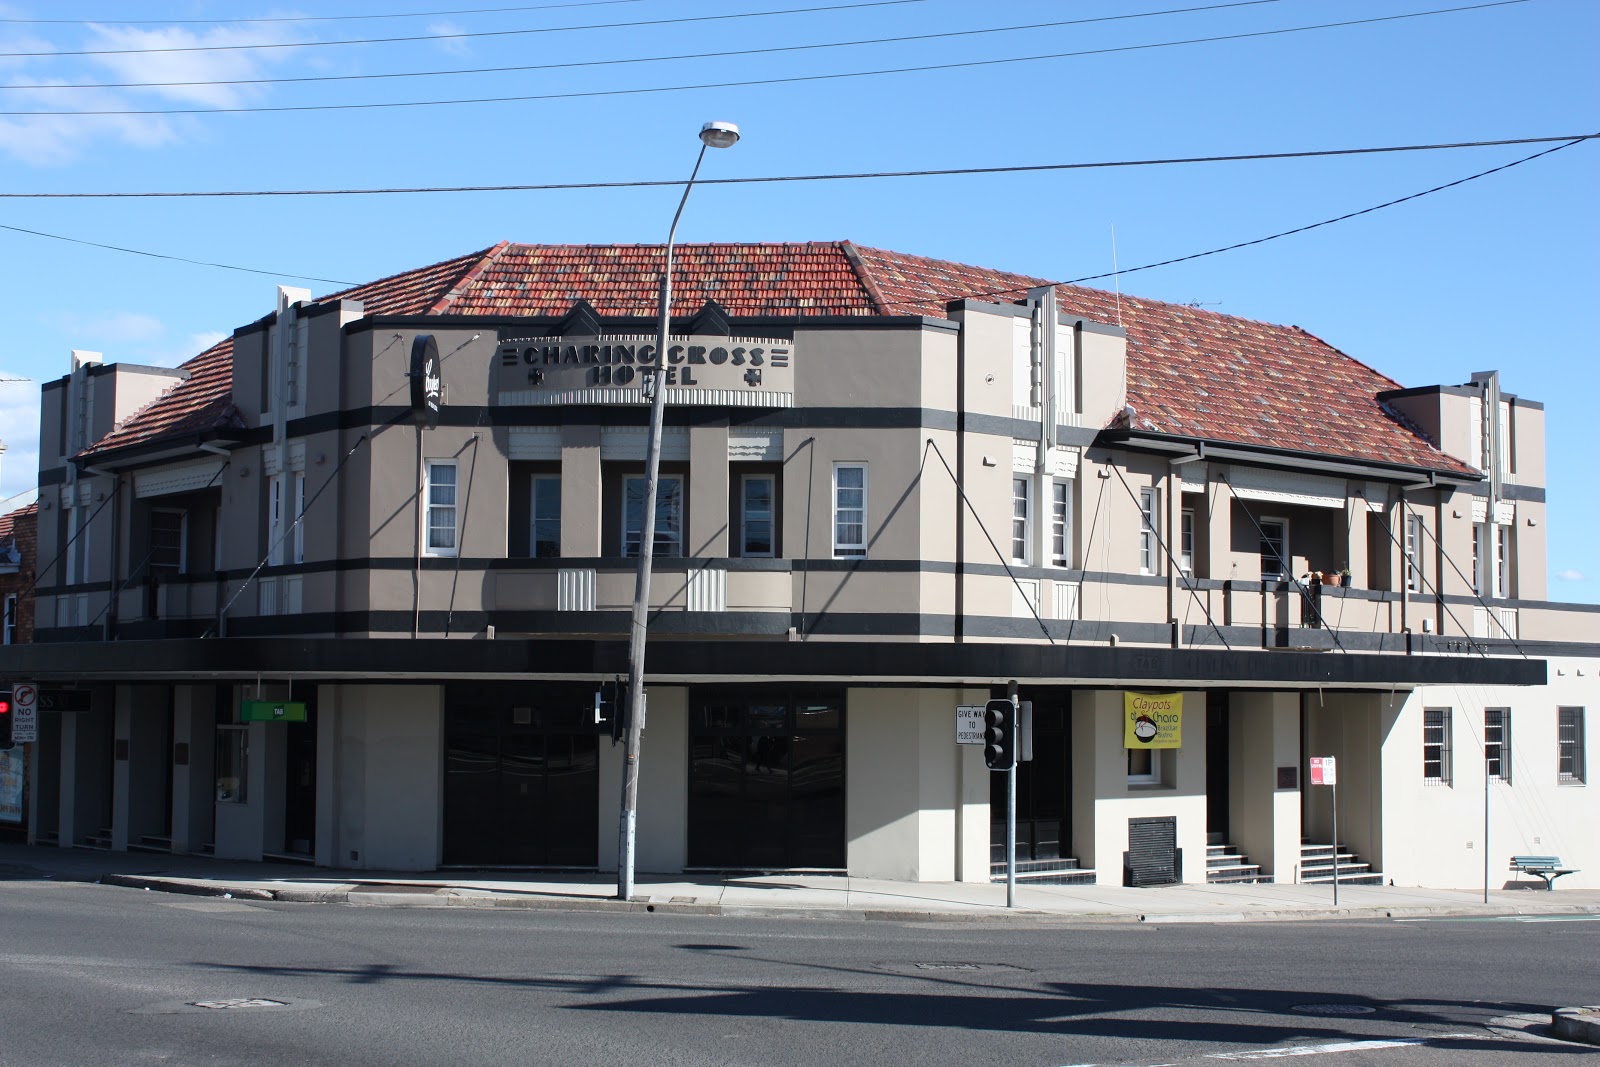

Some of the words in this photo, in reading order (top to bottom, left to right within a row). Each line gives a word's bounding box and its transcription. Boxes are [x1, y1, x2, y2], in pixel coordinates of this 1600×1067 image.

[523, 345, 658, 365] CHARING
[667, 346, 765, 366] CROSS
[592, 365, 698, 386] HOTEL
[1132, 697, 1171, 712] Claypots
[18, 708, 32, 716] NO
[958, 710, 971, 718] GIVE
[973, 710, 985, 718] WAY
[969, 721, 975, 729] TO
